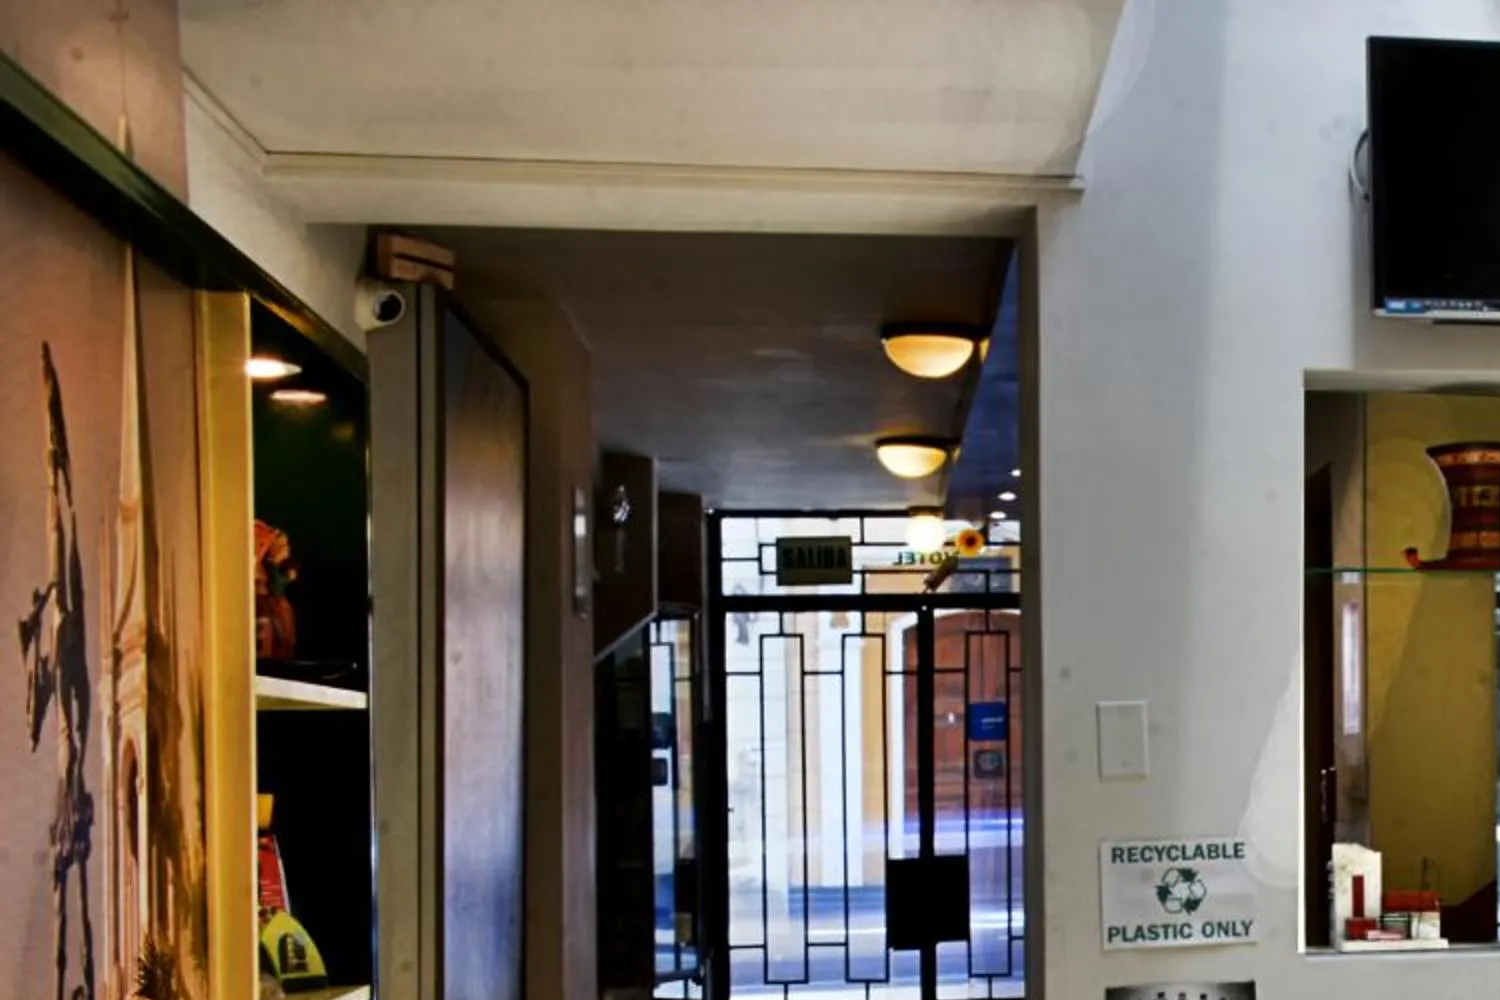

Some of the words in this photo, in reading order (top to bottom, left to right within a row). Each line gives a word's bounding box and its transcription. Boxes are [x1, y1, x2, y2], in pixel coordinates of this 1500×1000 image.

[1111, 842, 1246, 864] RECYCLABLE
[1108, 923, 1193, 944] PLASTIC
[1202, 920, 1254, 938] ONLY
